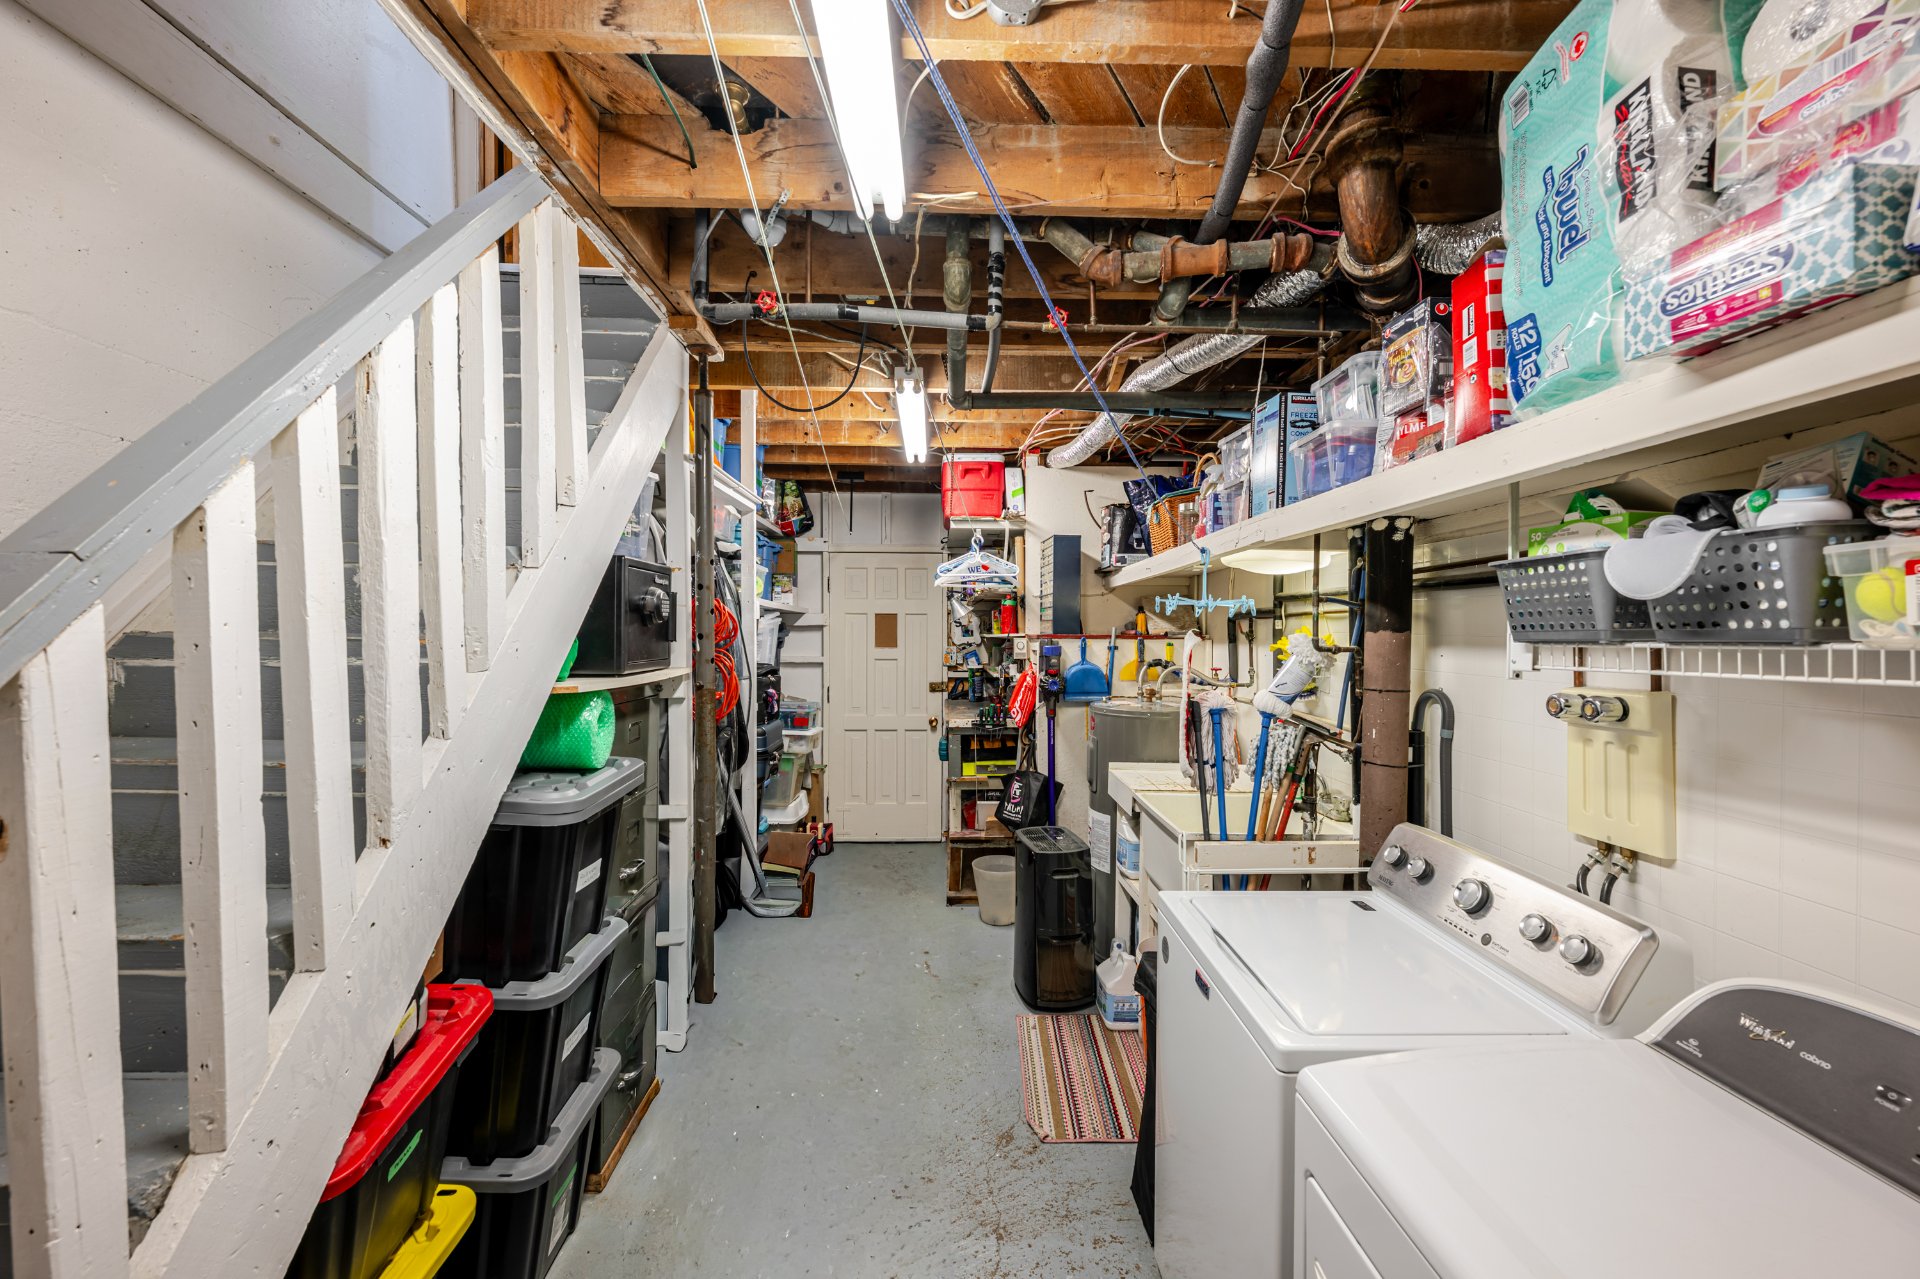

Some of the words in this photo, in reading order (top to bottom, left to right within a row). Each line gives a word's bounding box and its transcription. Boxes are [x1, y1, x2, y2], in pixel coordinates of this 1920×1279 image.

[1628, 86, 1654, 209] KIRKLAND
[1553, 144, 1591, 264] Towel
[1540, 220, 1549, 239] and
[1543, 239, 1553, 284] Absorbent
[1511, 327, 1521, 351] ROLLS
[1517, 319, 1537, 348] 12
[1521, 351, 1539, 393] 160
[1290, 411, 1318, 419] FREEZE
[1530, 532, 1542, 542] 50
[967, 565, 982, 574] WE
